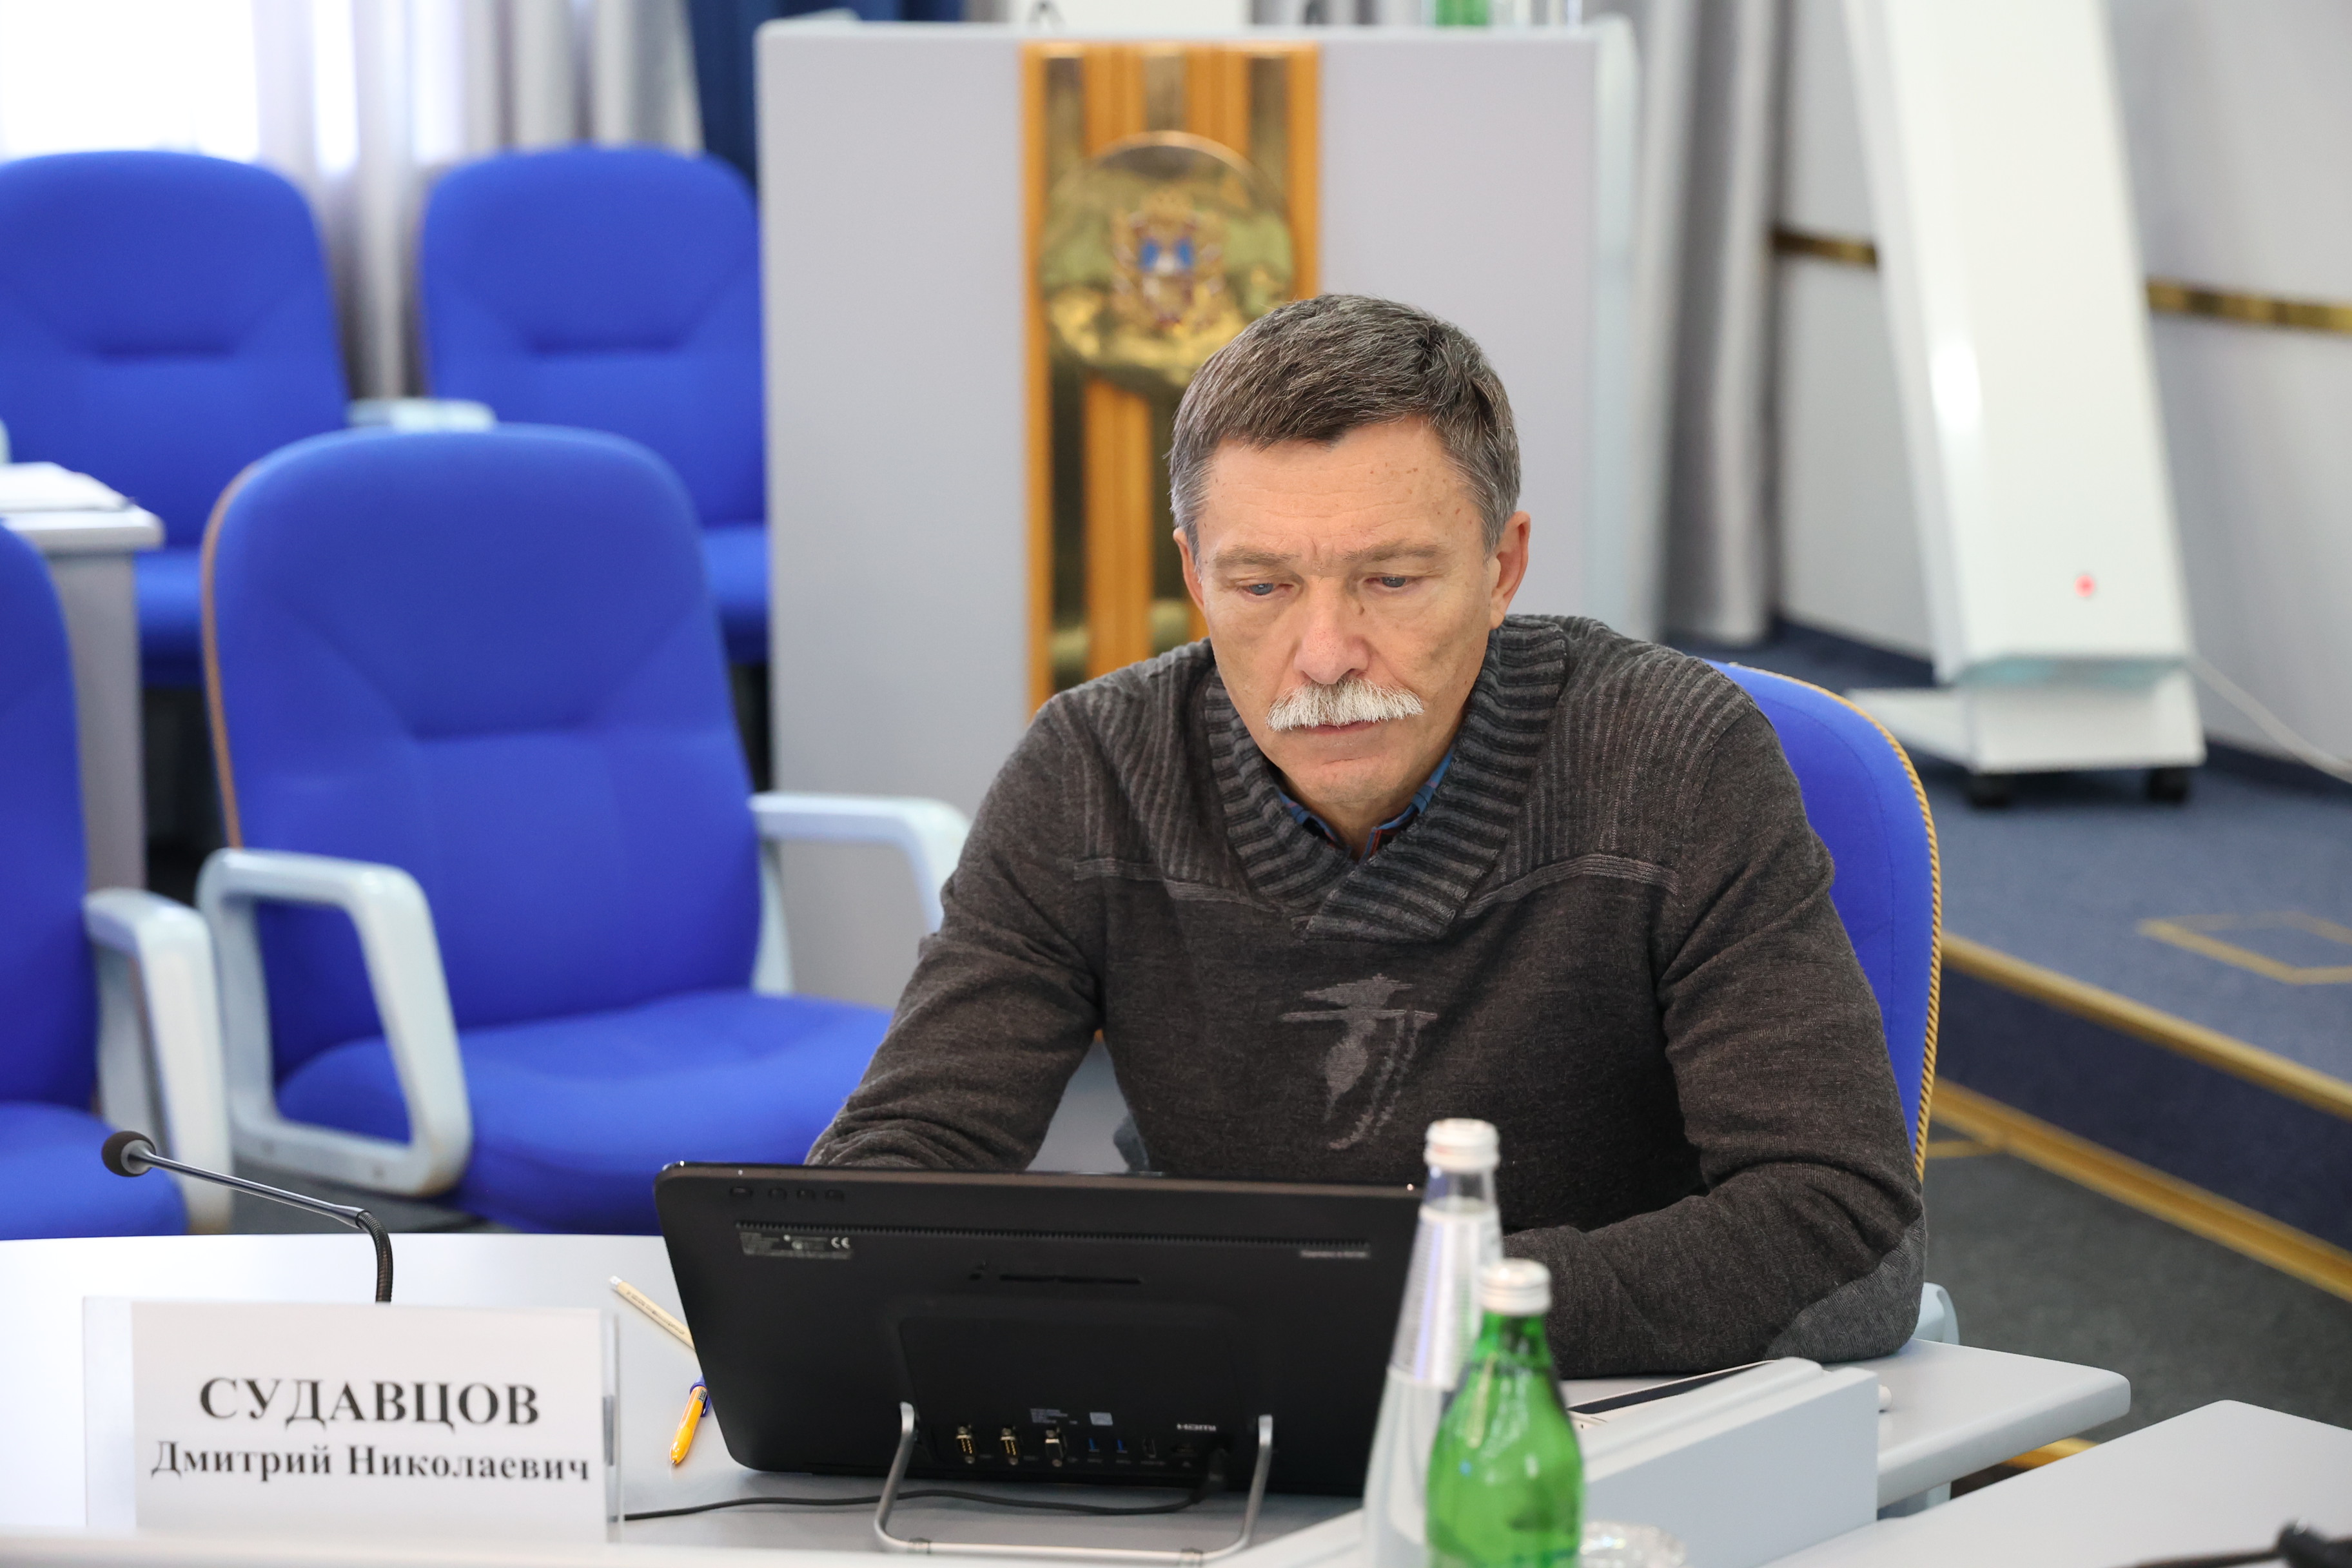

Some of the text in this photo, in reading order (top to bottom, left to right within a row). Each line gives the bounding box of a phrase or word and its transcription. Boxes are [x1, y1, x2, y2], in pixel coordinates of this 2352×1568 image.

[199, 1377, 540, 1433] СУДАВЦОВ
[151, 1441, 589, 1482] Дмитрий Николаевич
